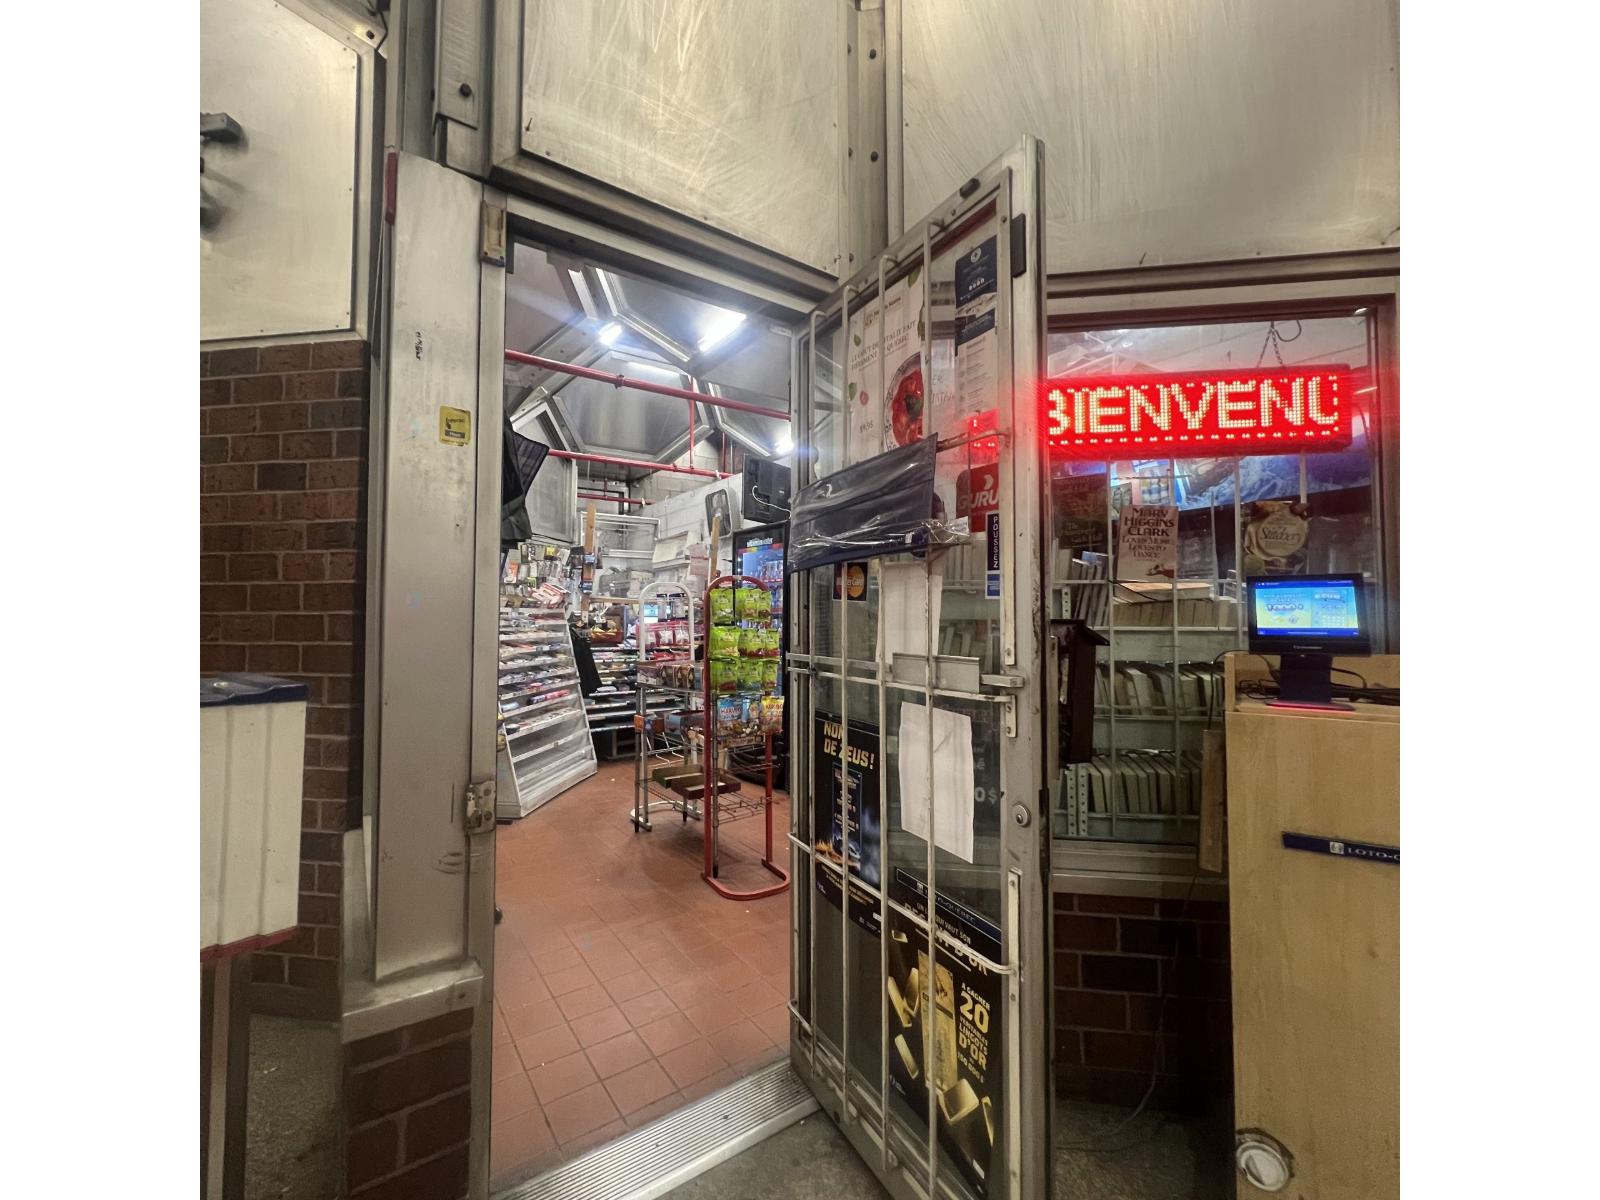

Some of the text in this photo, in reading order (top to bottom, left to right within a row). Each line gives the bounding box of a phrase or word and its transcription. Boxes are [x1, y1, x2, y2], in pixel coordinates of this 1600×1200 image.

[956, 488, 999, 509] GURU
[1124, 516, 1175, 528] HIGGINS
[1127, 527, 1170, 537] CLARK
[823, 738, 837, 756] DE
[966, 986, 991, 1012] GAGNER
[959, 990, 990, 1034] 20
[959, 1022, 988, 1056] LINGOTS
[959, 1031, 987, 1072] D'OR
